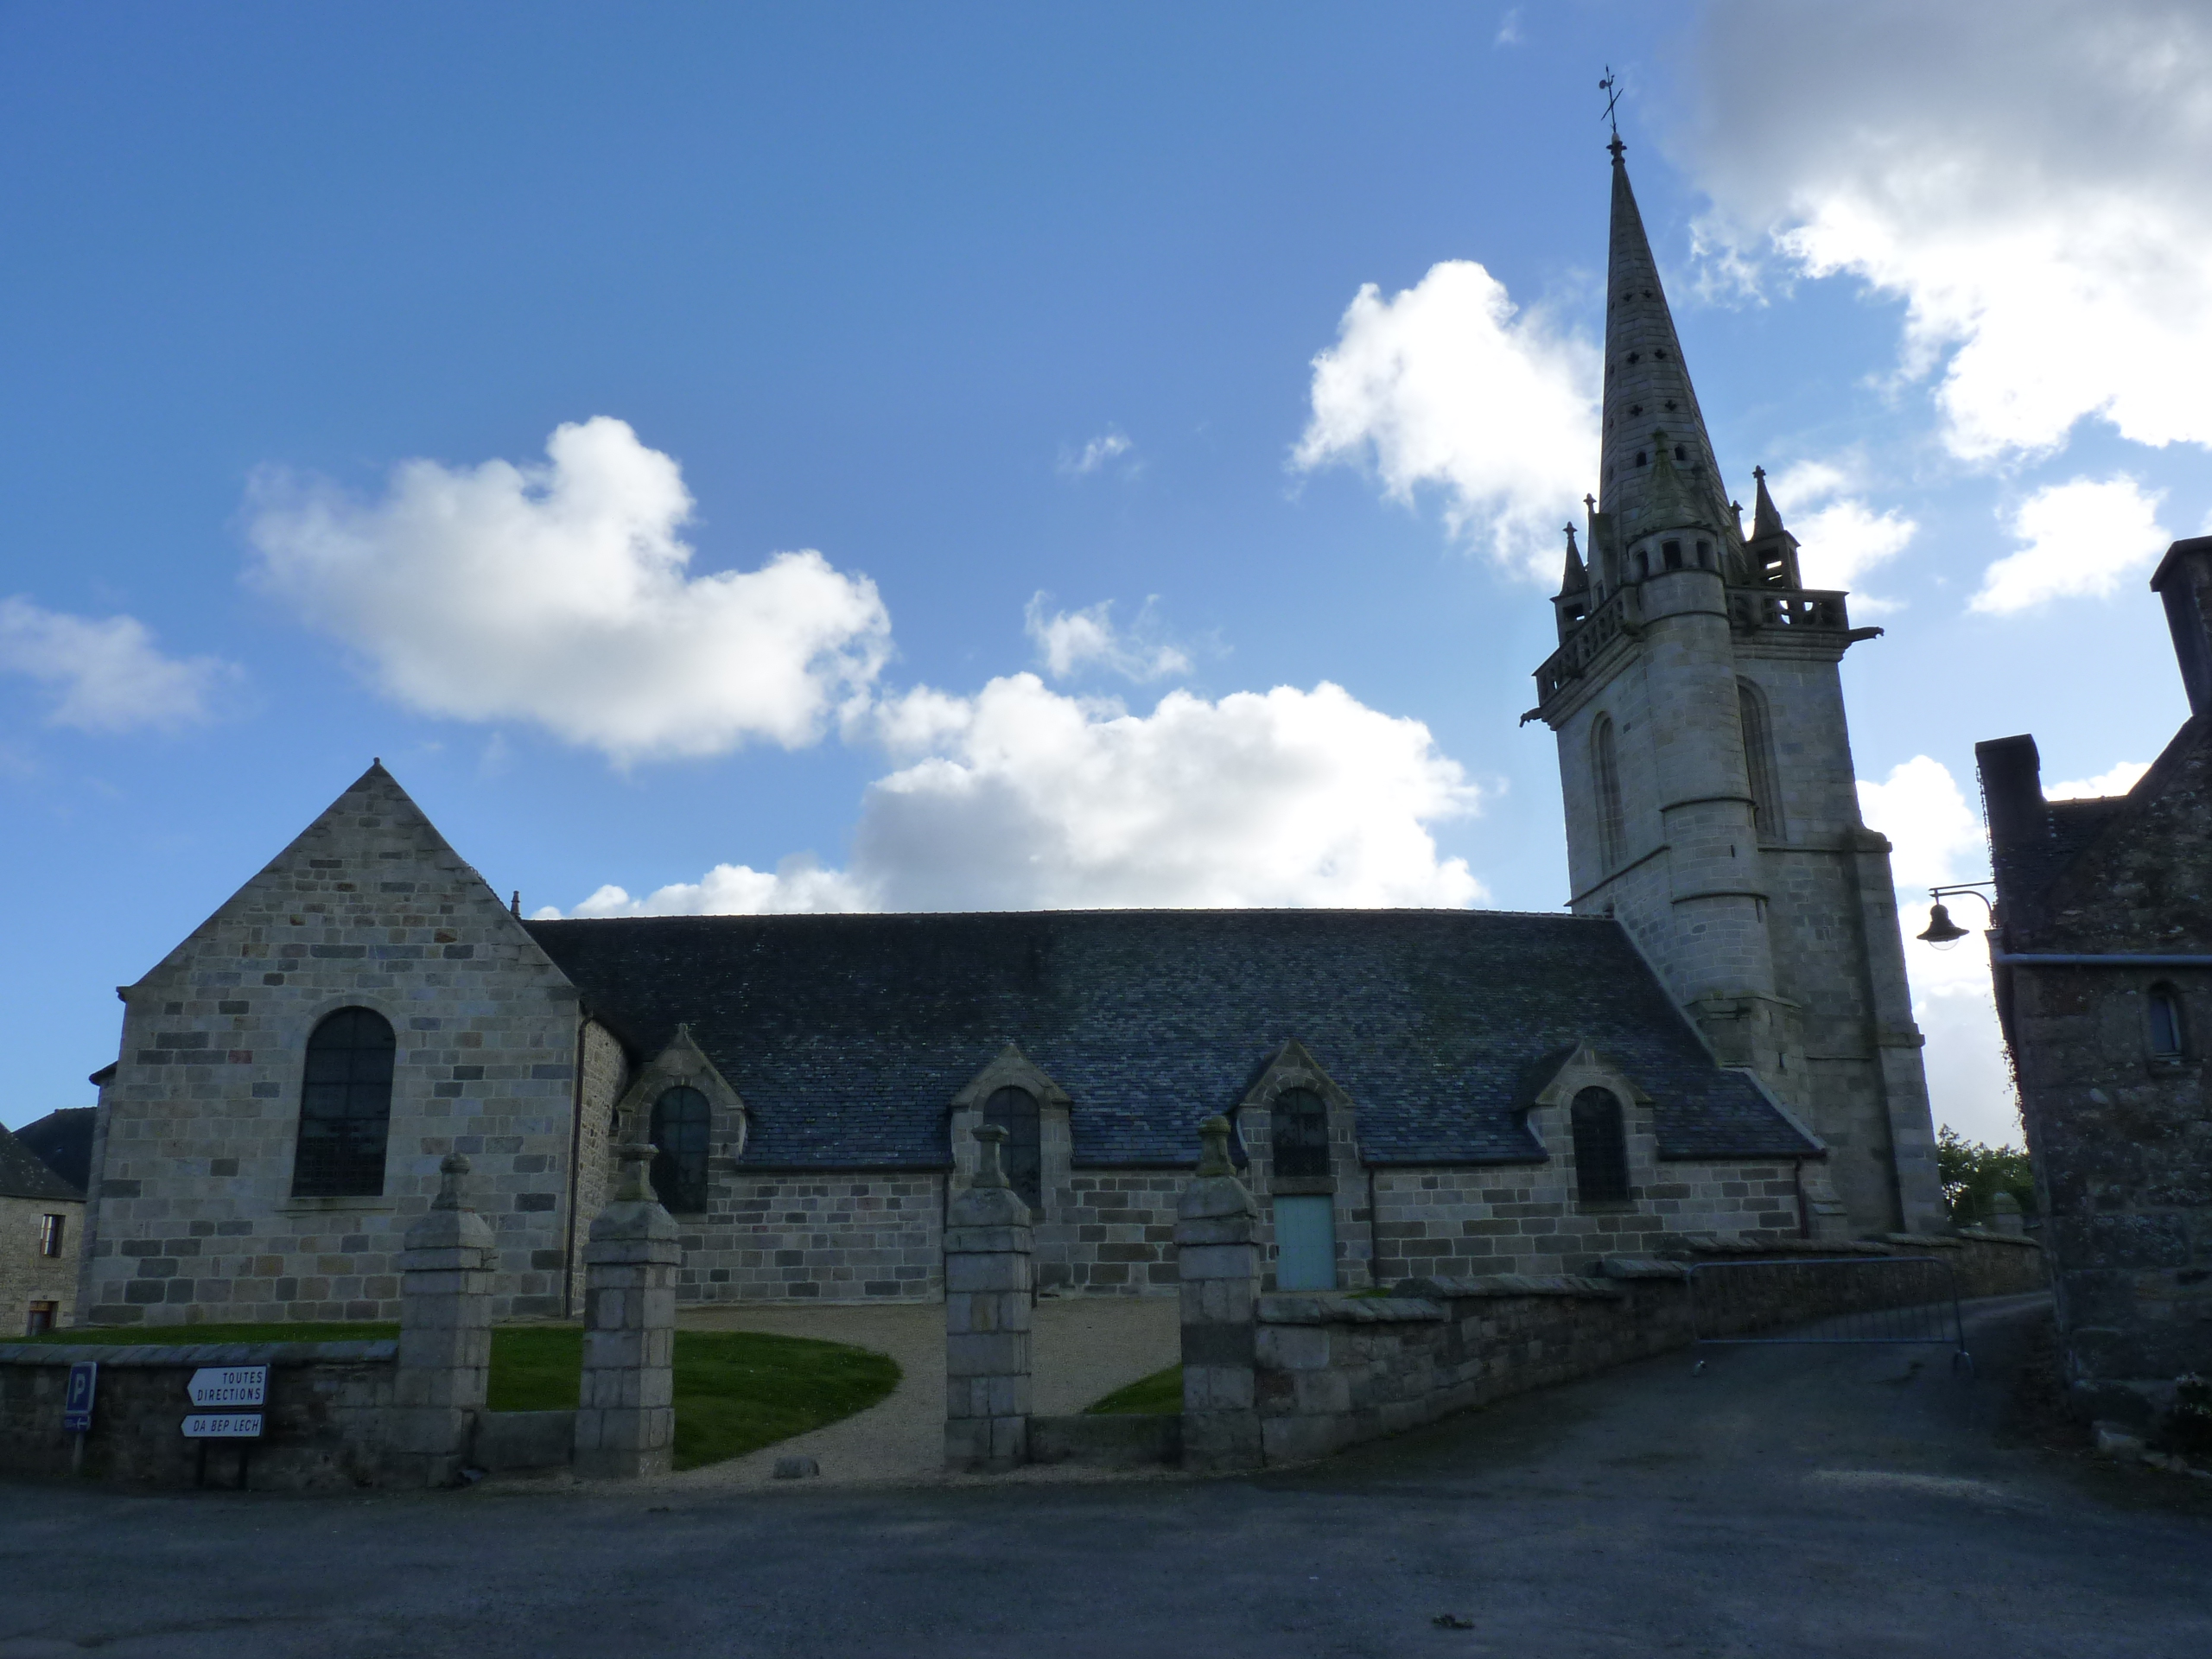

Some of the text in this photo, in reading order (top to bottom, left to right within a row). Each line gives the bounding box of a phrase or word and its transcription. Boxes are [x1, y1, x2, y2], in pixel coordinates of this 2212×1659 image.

[223, 1371, 263, 1384] TOUTES
[73, 1373, 86, 1404] P
[198, 1389, 261, 1402] DIRECTIONS
[193, 1420, 206, 1432] DA
[211, 1419, 229, 1432] BEP
